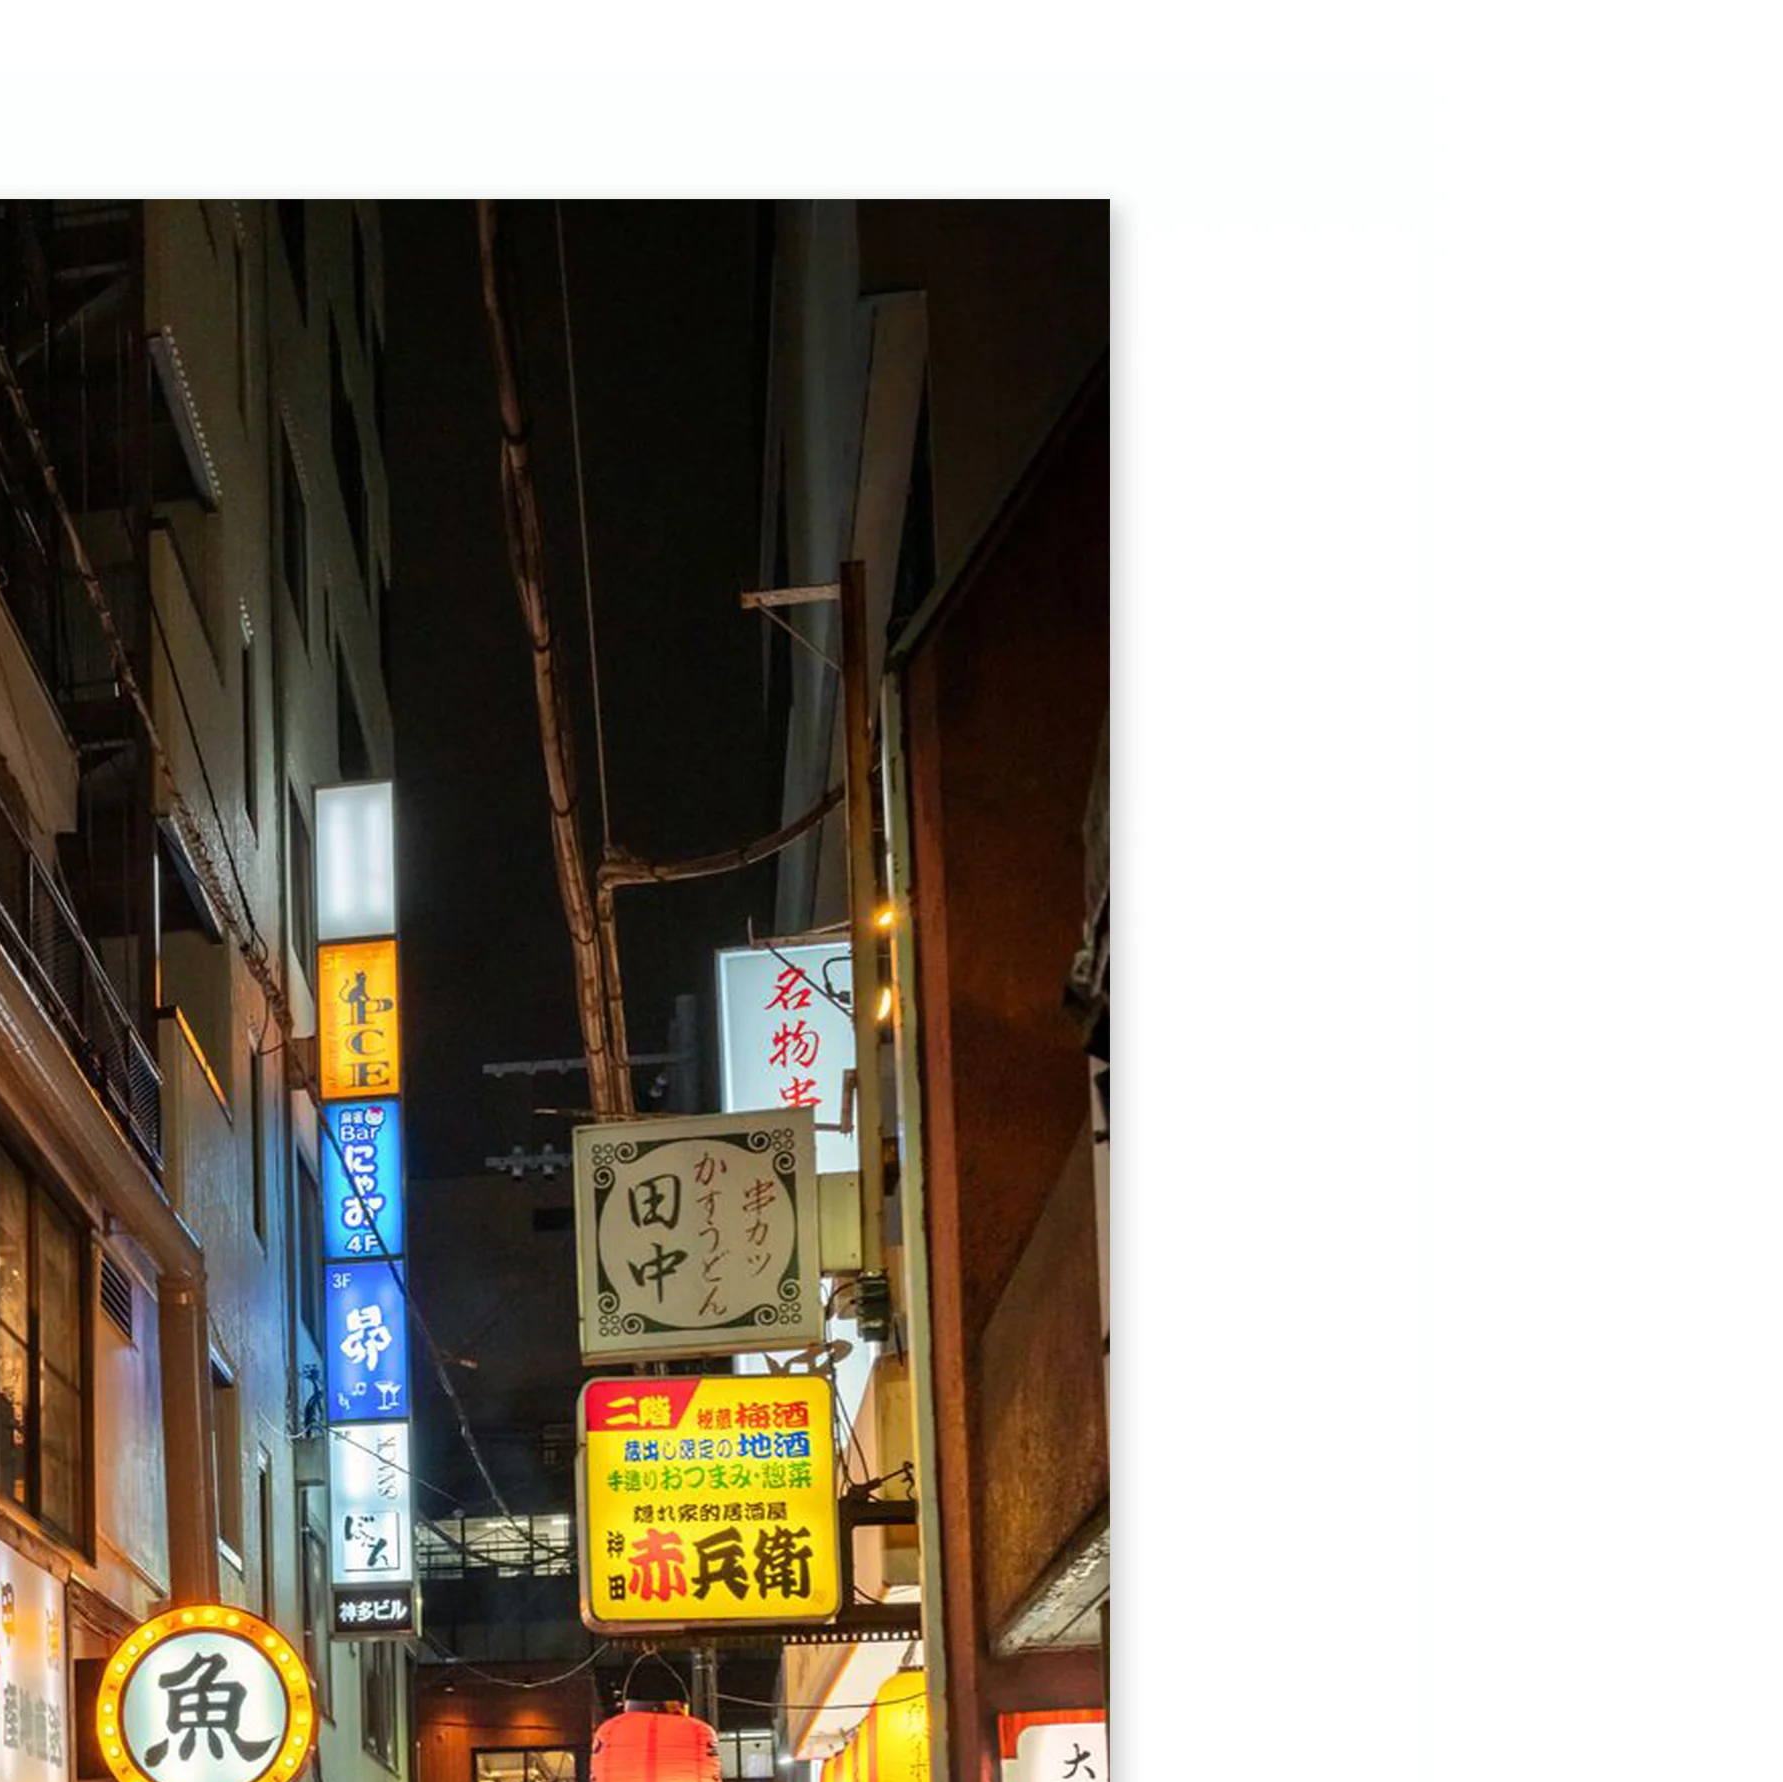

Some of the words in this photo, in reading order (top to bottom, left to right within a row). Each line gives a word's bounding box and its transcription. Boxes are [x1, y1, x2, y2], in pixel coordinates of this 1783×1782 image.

[340, 1125, 379, 1141] Bar
[346, 1234, 379, 1252] 4F
[627, 1173, 687, 1302] 田中
[694, 1152, 727, 1317] かすうどん
[742, 1179, 776, 1279] 串カツ
[333, 1274, 351, 1288] 3F
[605, 1396, 671, 1427] 二階
[628, 1526, 813, 1601] 赤兵衛
[144, 1652, 279, 1768] 魚
